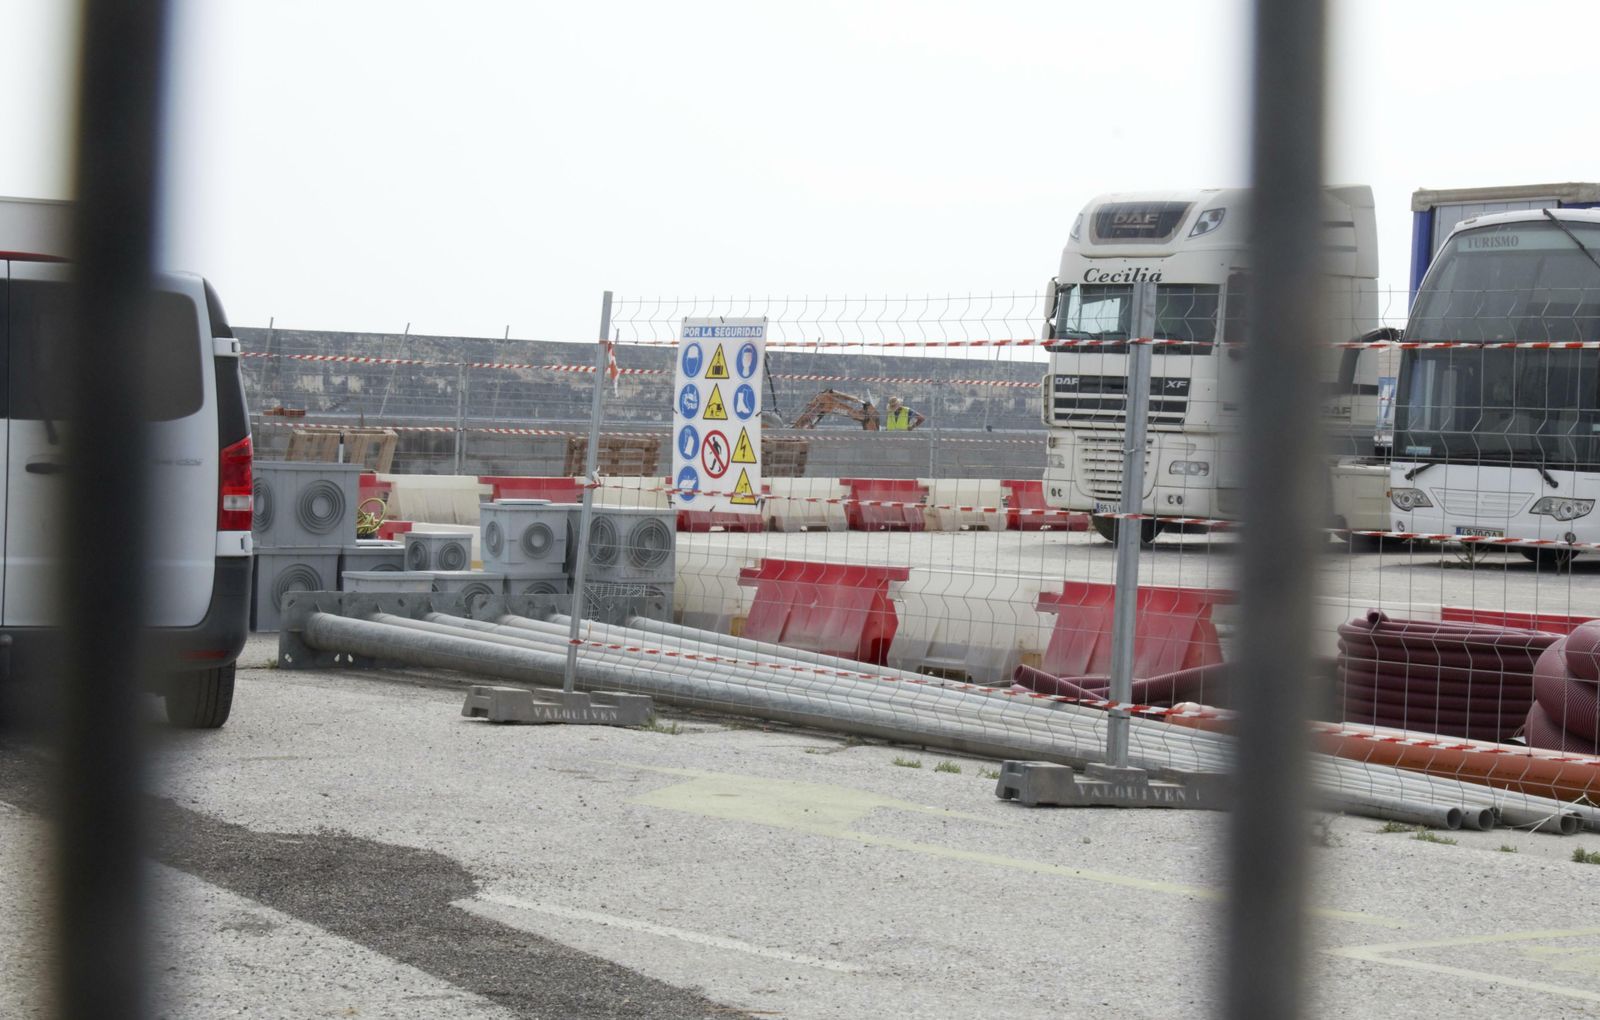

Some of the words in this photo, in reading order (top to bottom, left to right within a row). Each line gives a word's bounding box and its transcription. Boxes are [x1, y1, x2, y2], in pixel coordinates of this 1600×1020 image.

[1113, 213, 1159, 224] DAF
[1467, 235, 1519, 249] TURISMO
[1083, 267, 1163, 283] Cecilia
[683, 327, 700, 337] POR
[702, 327, 713, 337] LA
[714, 326, 762, 337] SEGURIDAD
[1055, 377, 1079, 385] DAF
[1166, 380, 1187, 389] XF
